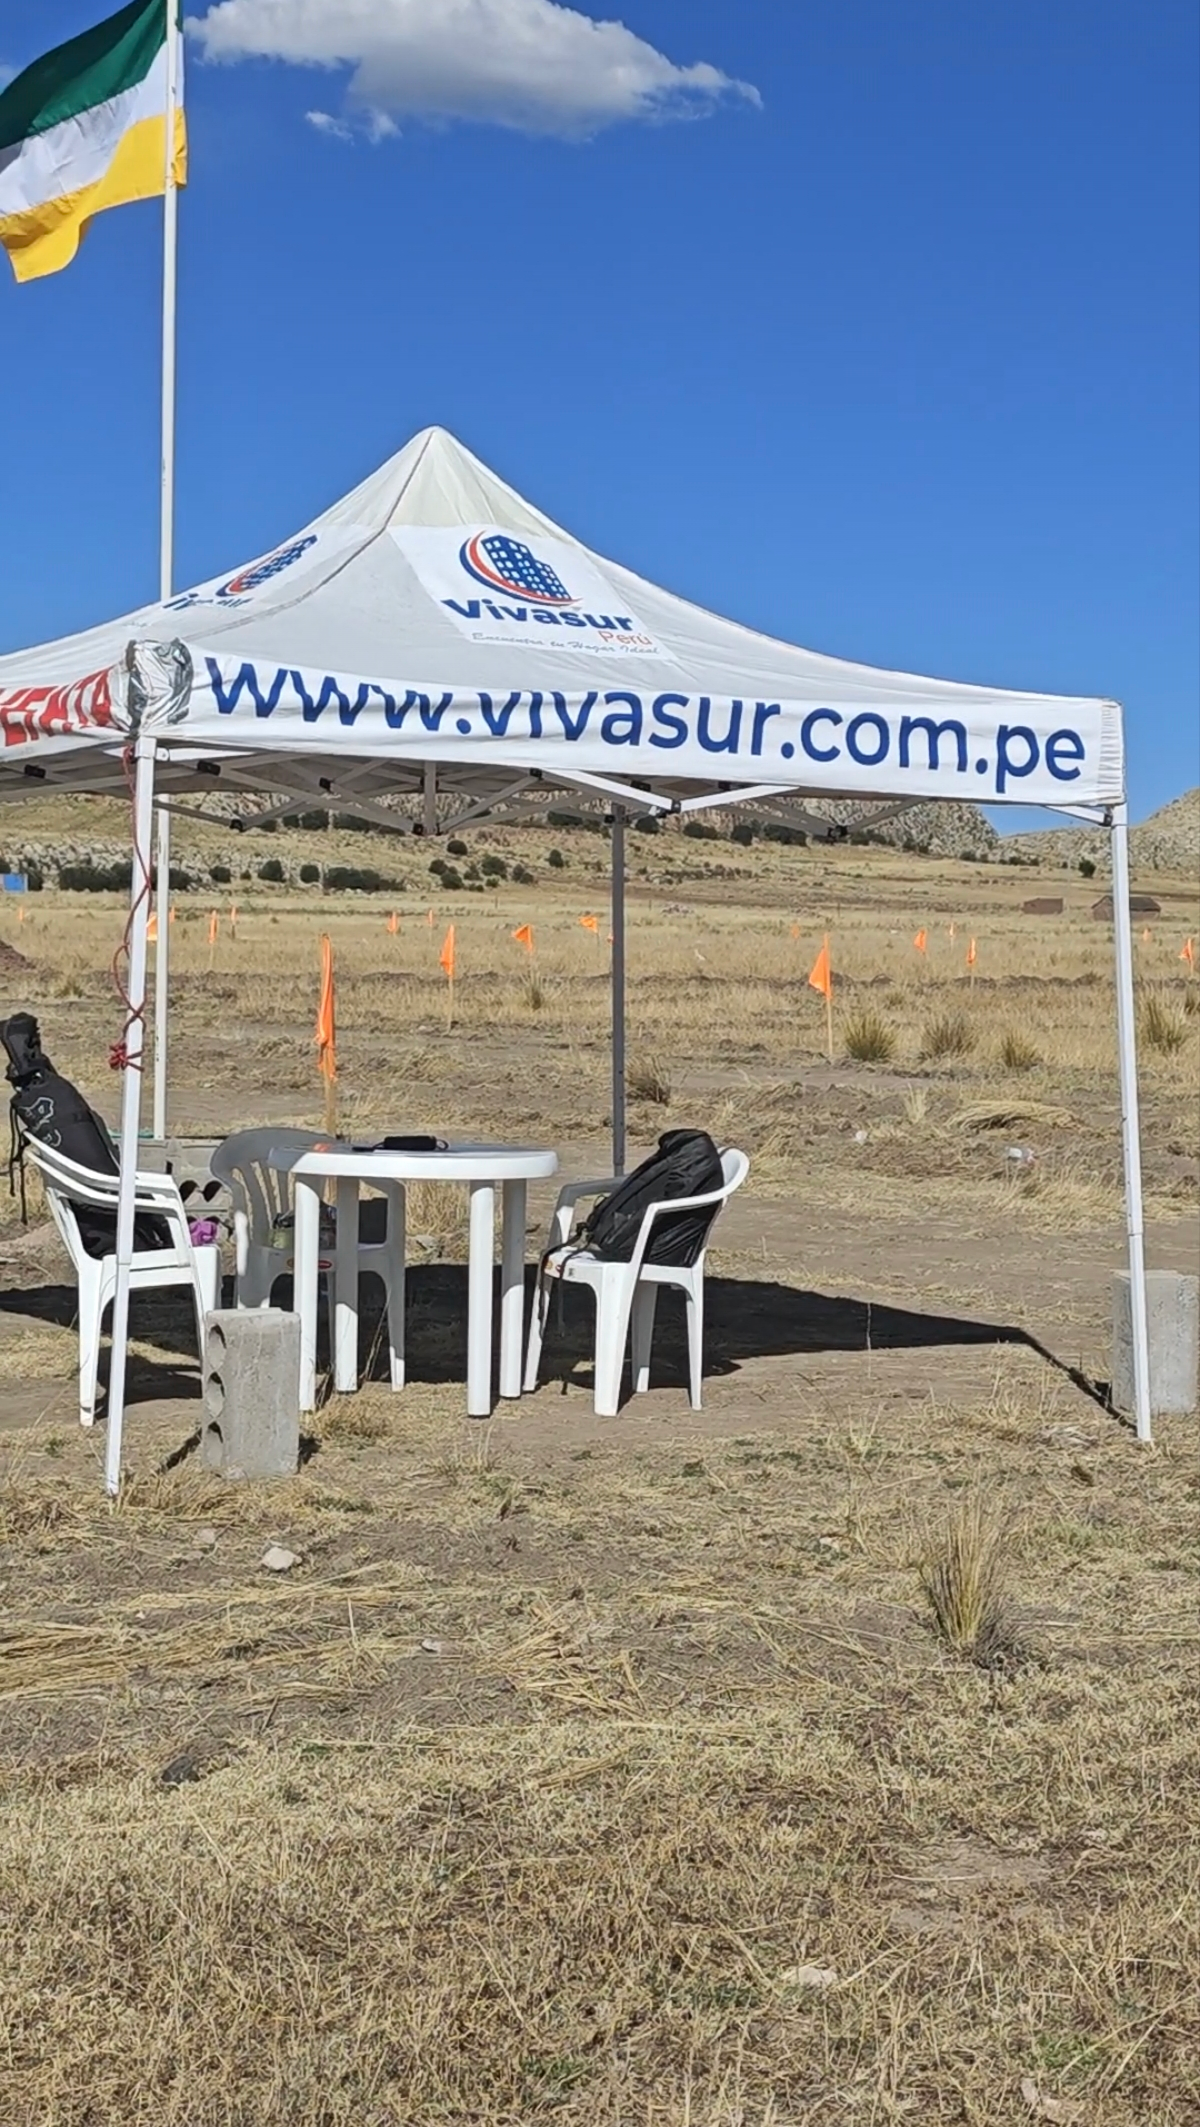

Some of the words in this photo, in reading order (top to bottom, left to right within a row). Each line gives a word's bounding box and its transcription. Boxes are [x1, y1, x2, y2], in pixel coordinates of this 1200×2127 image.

[441, 598, 633, 631] Vivasur
[471, 632, 546, 646] Encuentra
[567, 641, 616, 653] Hogar
[598, 630, 653, 646] Perú
[205, 656, 1086, 793] www.vivasur.com.pe
